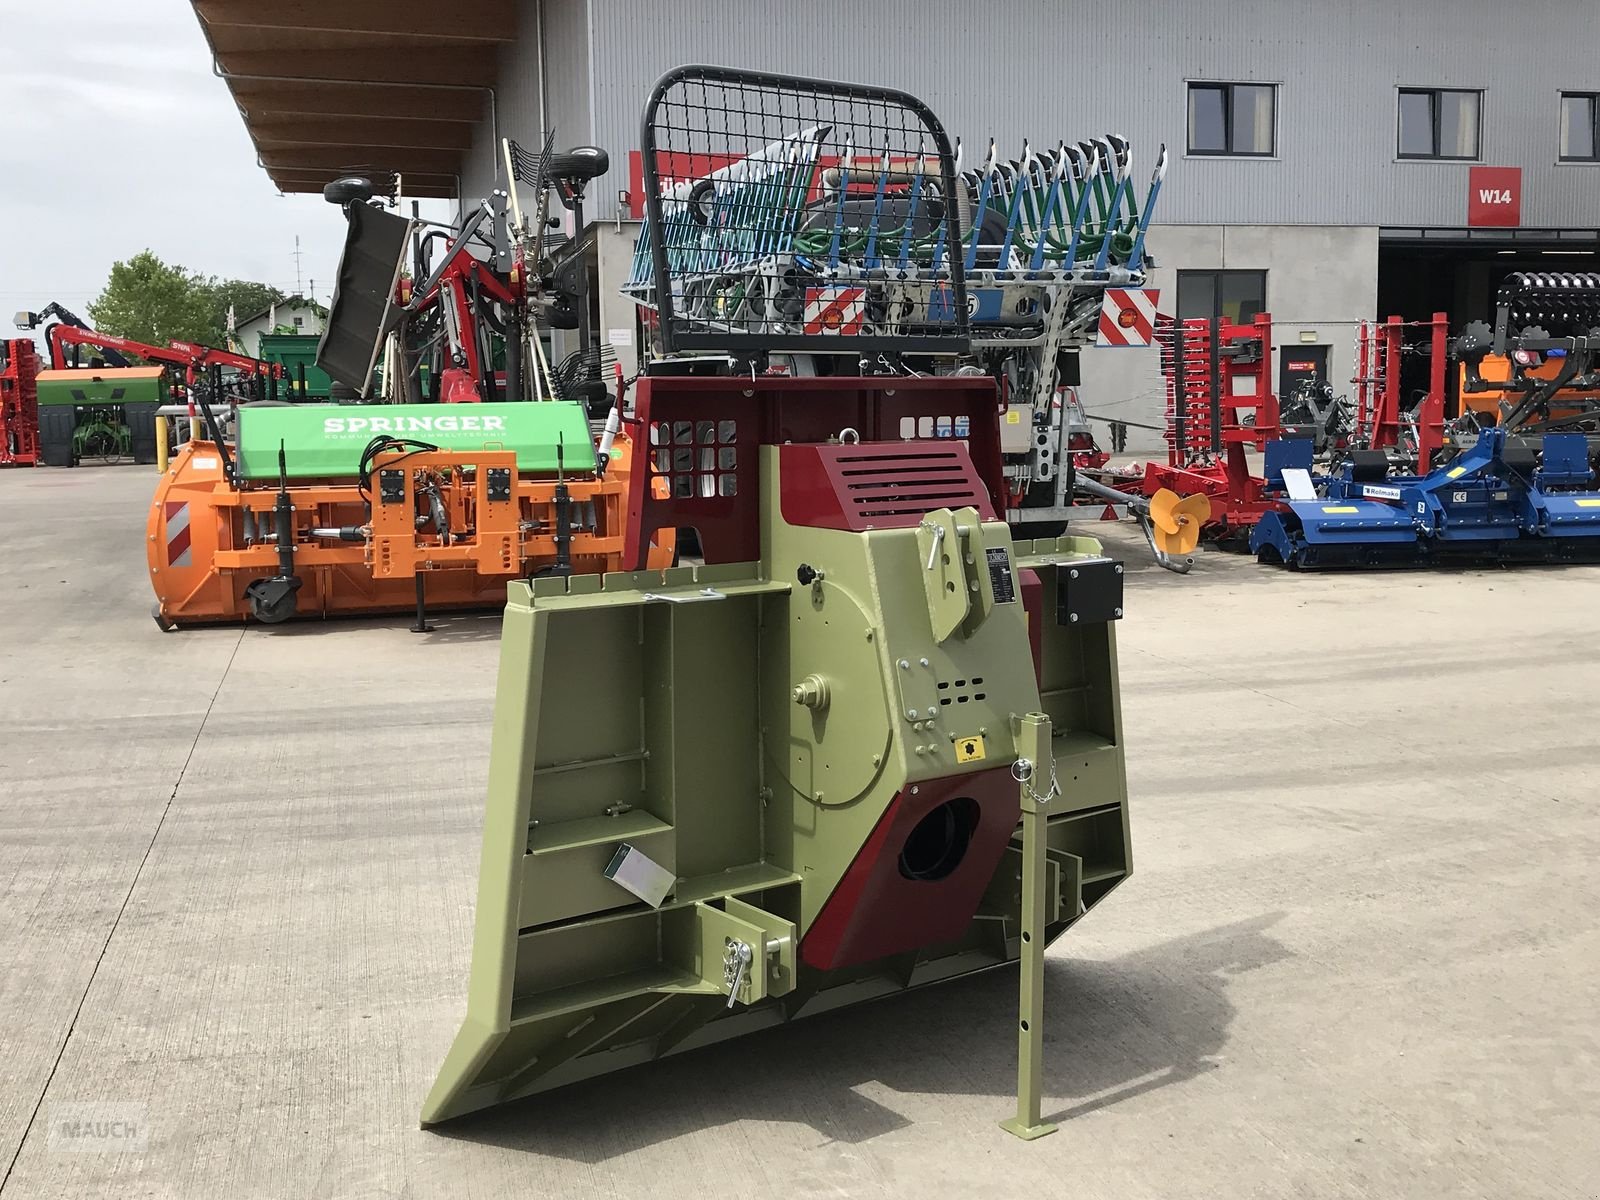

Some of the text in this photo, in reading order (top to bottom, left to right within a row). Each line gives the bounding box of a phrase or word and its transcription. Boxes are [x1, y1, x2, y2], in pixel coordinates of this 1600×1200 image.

[1479, 189, 1512, 204] W14
[323, 416, 506, 433] SPRINGER
[1370, 488, 1399, 497] Rolmako
